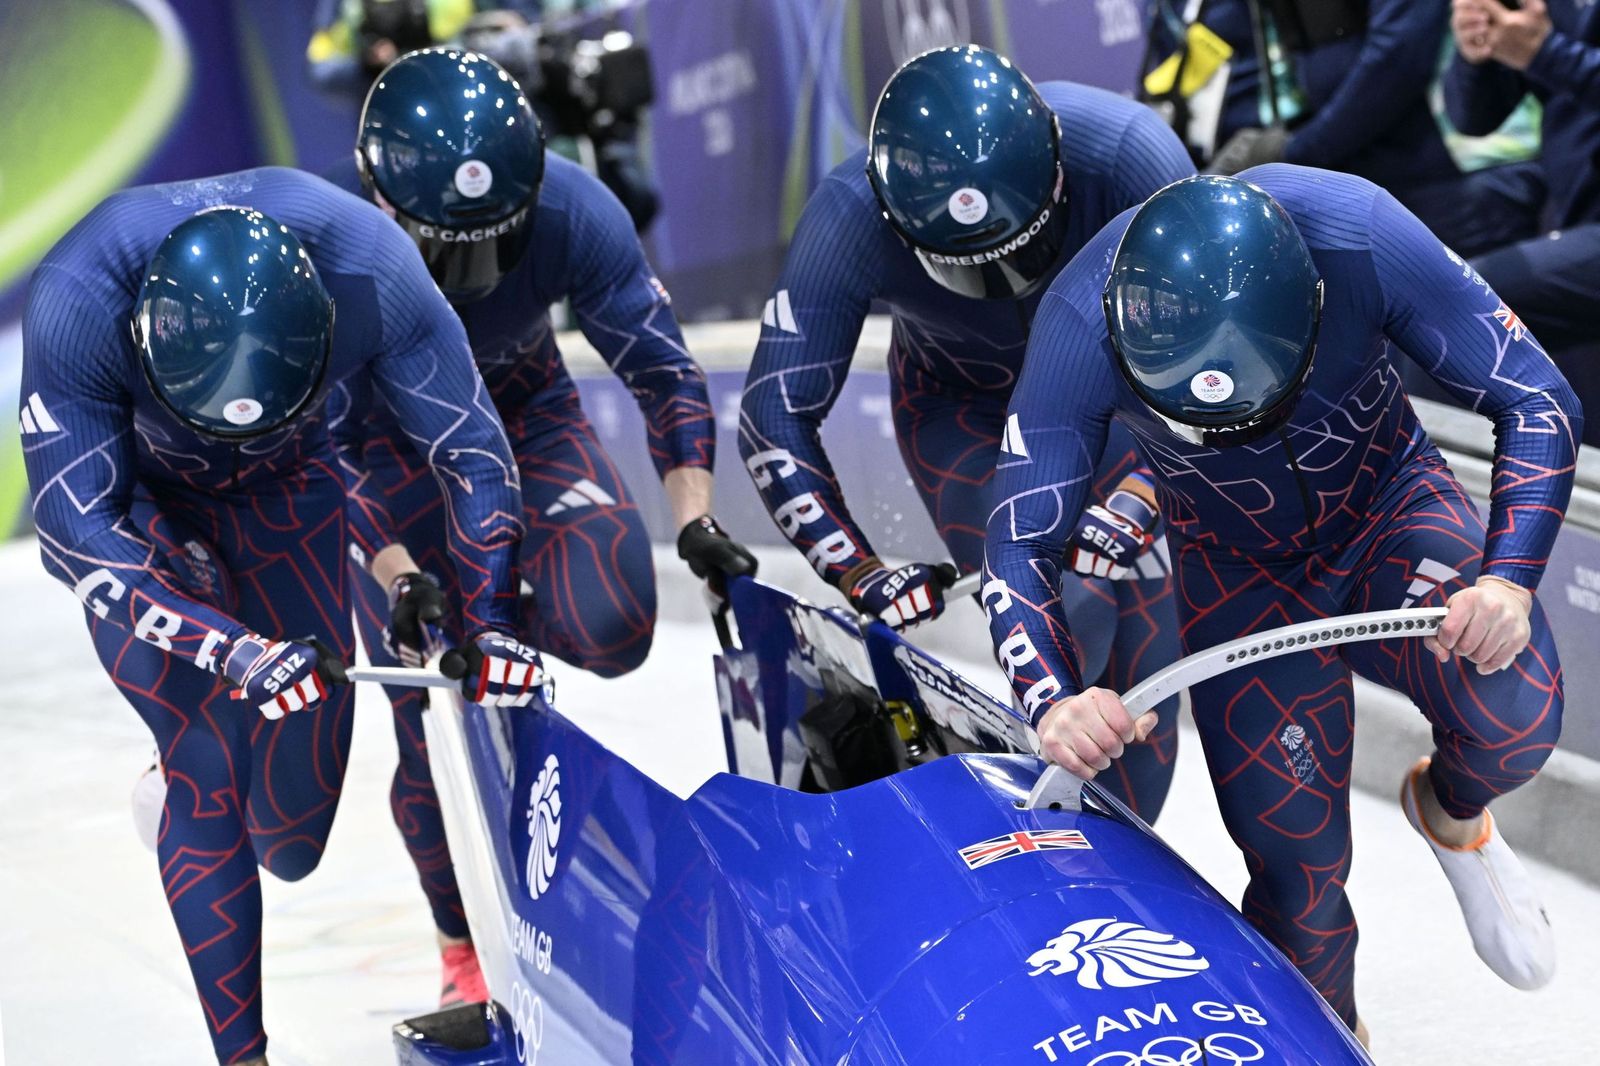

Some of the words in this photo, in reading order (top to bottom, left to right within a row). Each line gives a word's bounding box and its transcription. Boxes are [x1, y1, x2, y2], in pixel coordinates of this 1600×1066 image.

[930, 209, 1050, 266] GREENWOOD
[511, 911, 537, 966] TEAM
[536, 931, 553, 975] GB
[1033, 1002, 1178, 1063] TEAM
[1192, 1000, 1268, 1027] GB
